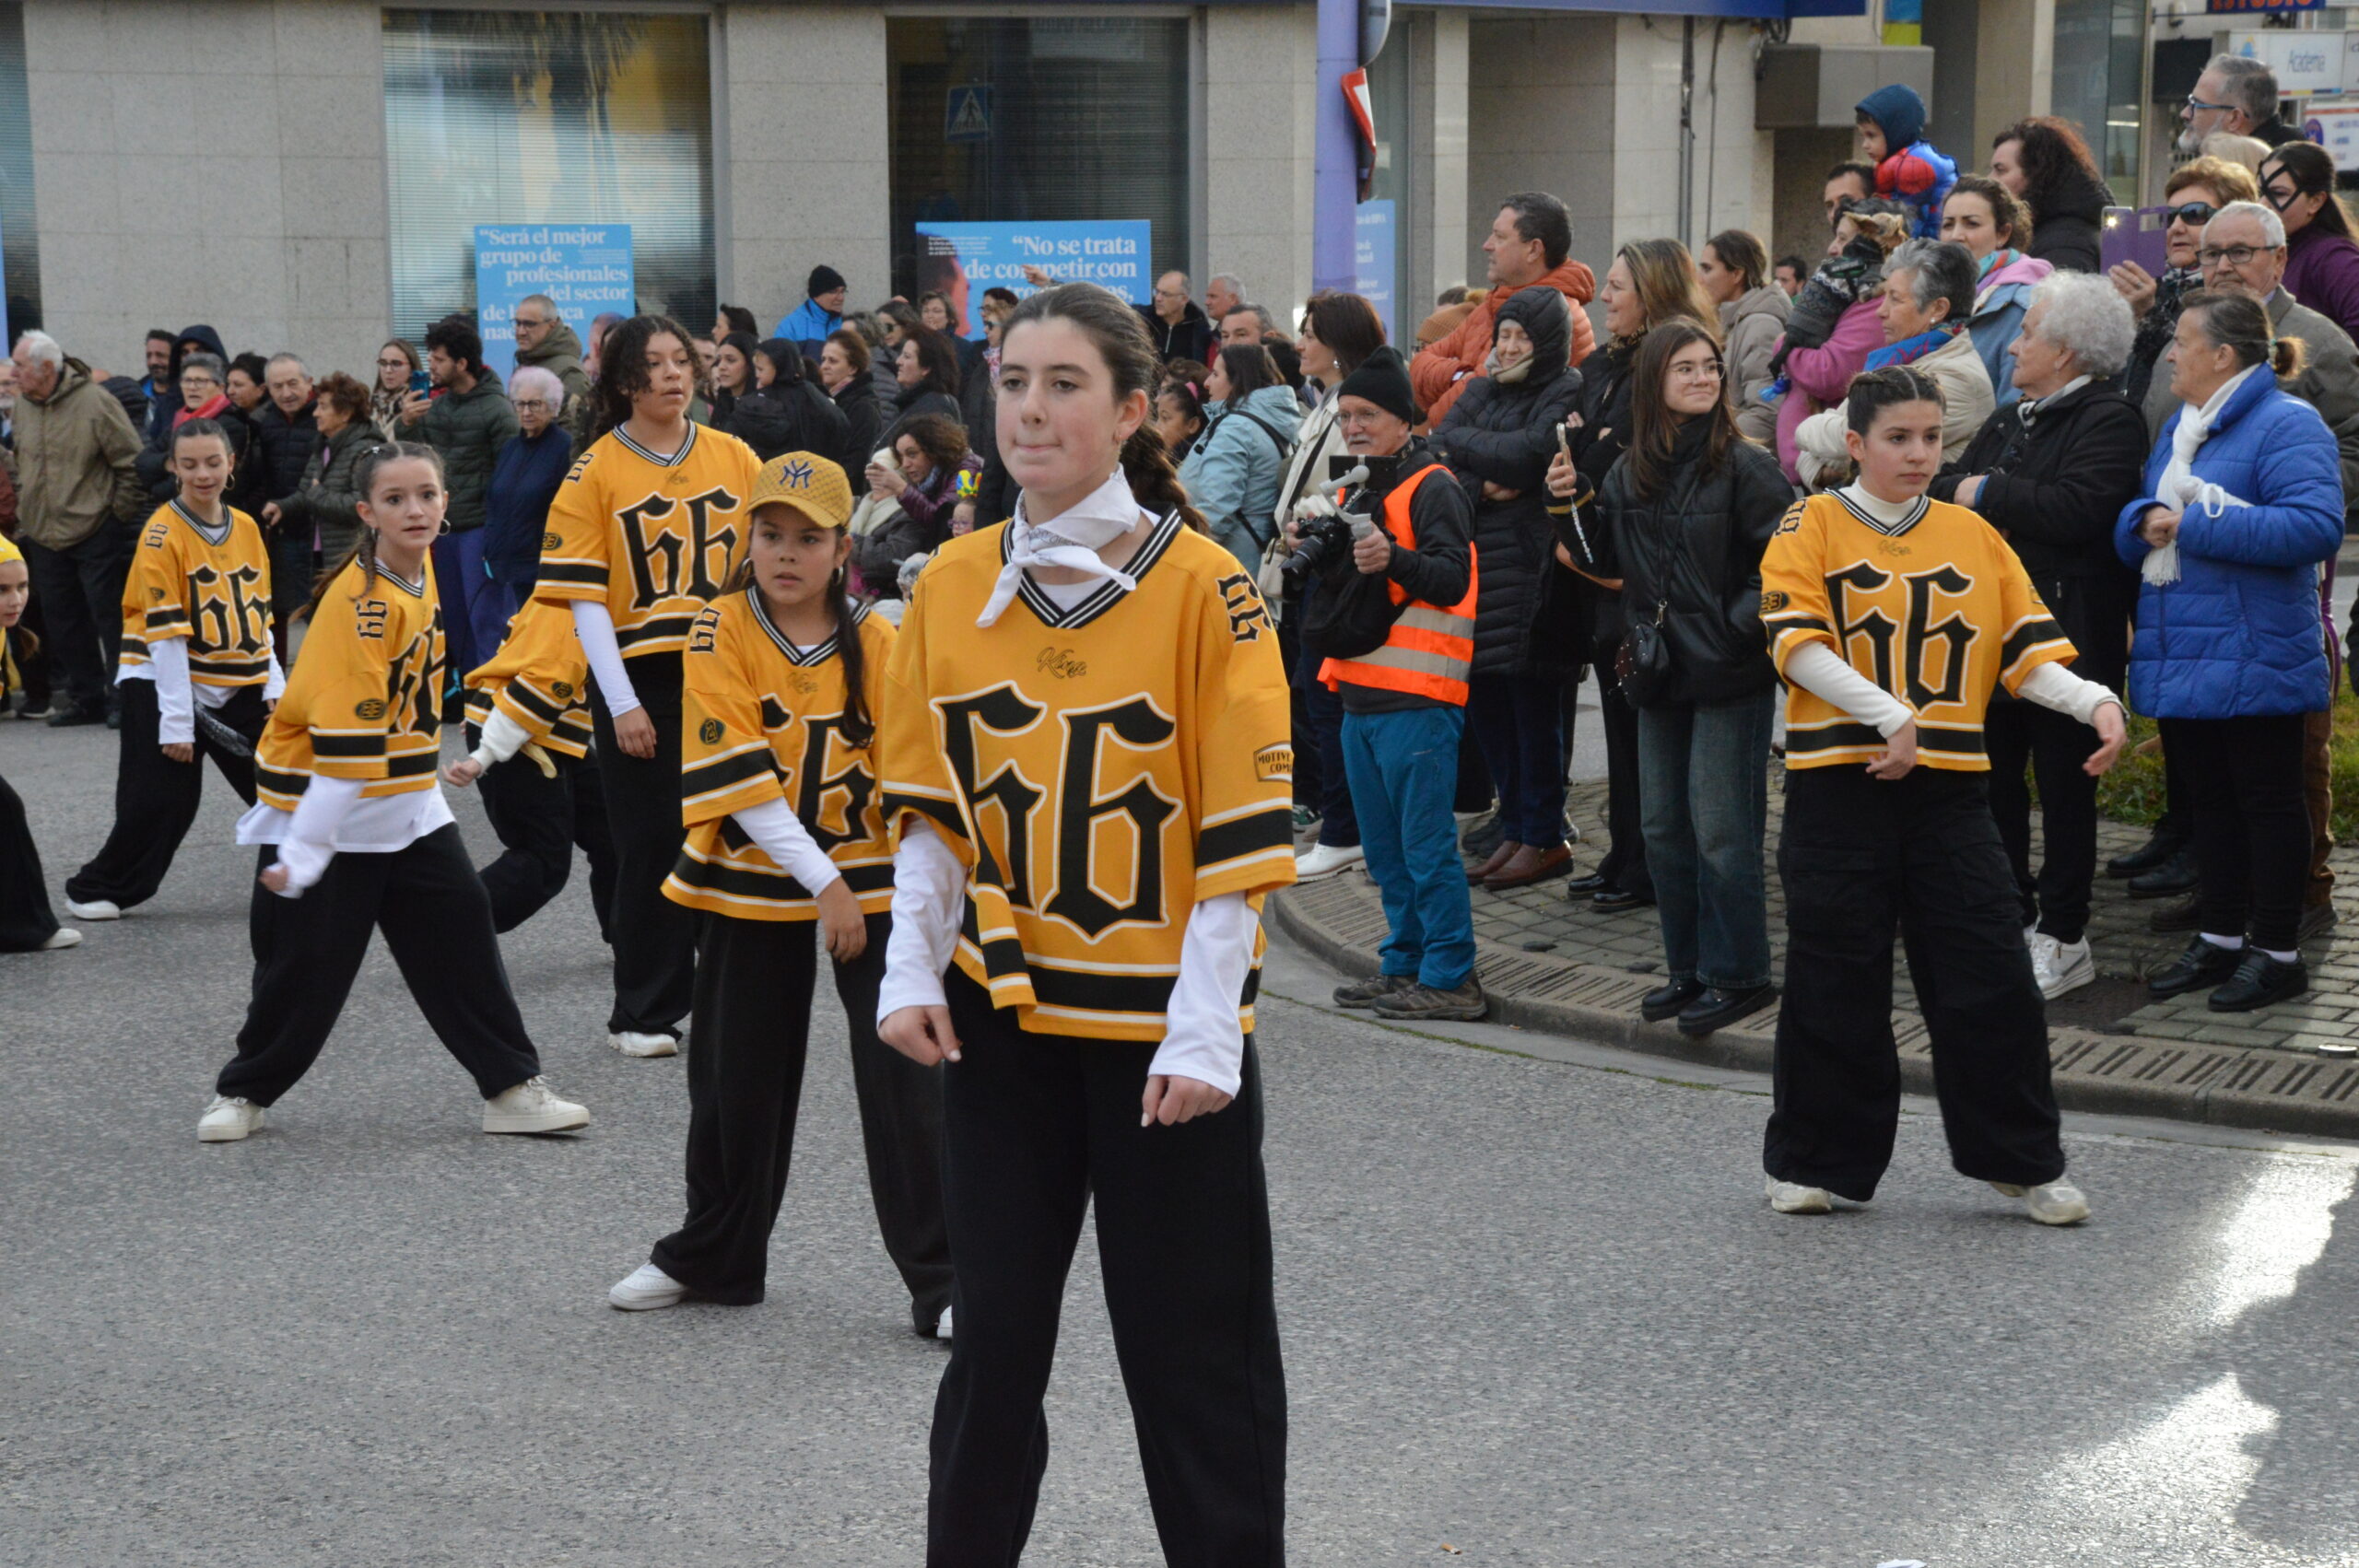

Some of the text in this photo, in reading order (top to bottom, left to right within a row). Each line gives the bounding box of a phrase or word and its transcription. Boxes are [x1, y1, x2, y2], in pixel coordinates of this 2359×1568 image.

[533, 228, 548, 244] el
[554, 228, 605, 247] mejor
[1012, 235, 1052, 255] “No
[1058, 240, 1079, 254] se
[1085, 237, 1136, 254] trata
[480, 251, 536, 268] grupo
[540, 247, 562, 263] de
[966, 258, 991, 279] de
[1097, 262, 1136, 277] con
[507, 264, 628, 287] profesionales
[544, 285, 629, 300] del sector
[483, 305, 505, 321] de
[779, 460, 814, 489] NY
[615, 485, 741, 613] 66
[186, 562, 270, 658] 66
[1825, 558, 1981, 717] 66
[928, 679, 1183, 946] 66
